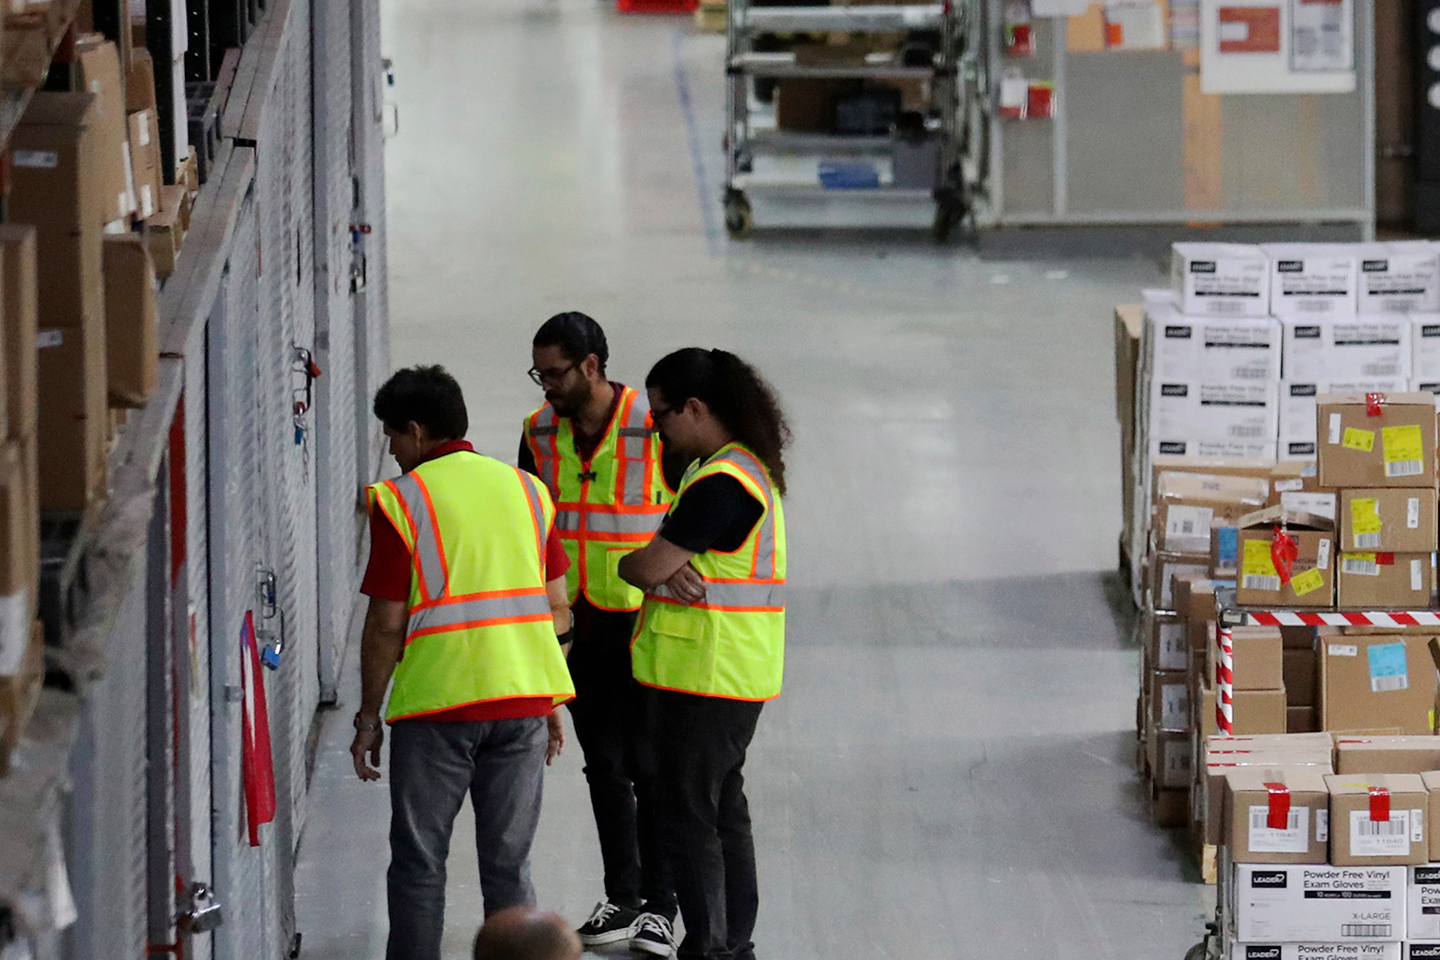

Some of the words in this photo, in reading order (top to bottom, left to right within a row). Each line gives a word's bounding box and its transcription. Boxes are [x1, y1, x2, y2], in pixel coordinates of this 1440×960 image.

[1303, 870, 1340, 879] Powder
[1342, 870, 1364, 879] Free
[1366, 870, 1390, 880] Vinyl
[1303, 880, 1330, 889] Exam
[1332, 880, 1365, 889] Gloves
[1298, 945, 1334, 953] Powder
[1336, 945, 1358, 953] Free
[1360, 945, 1384, 955] Vinyl
